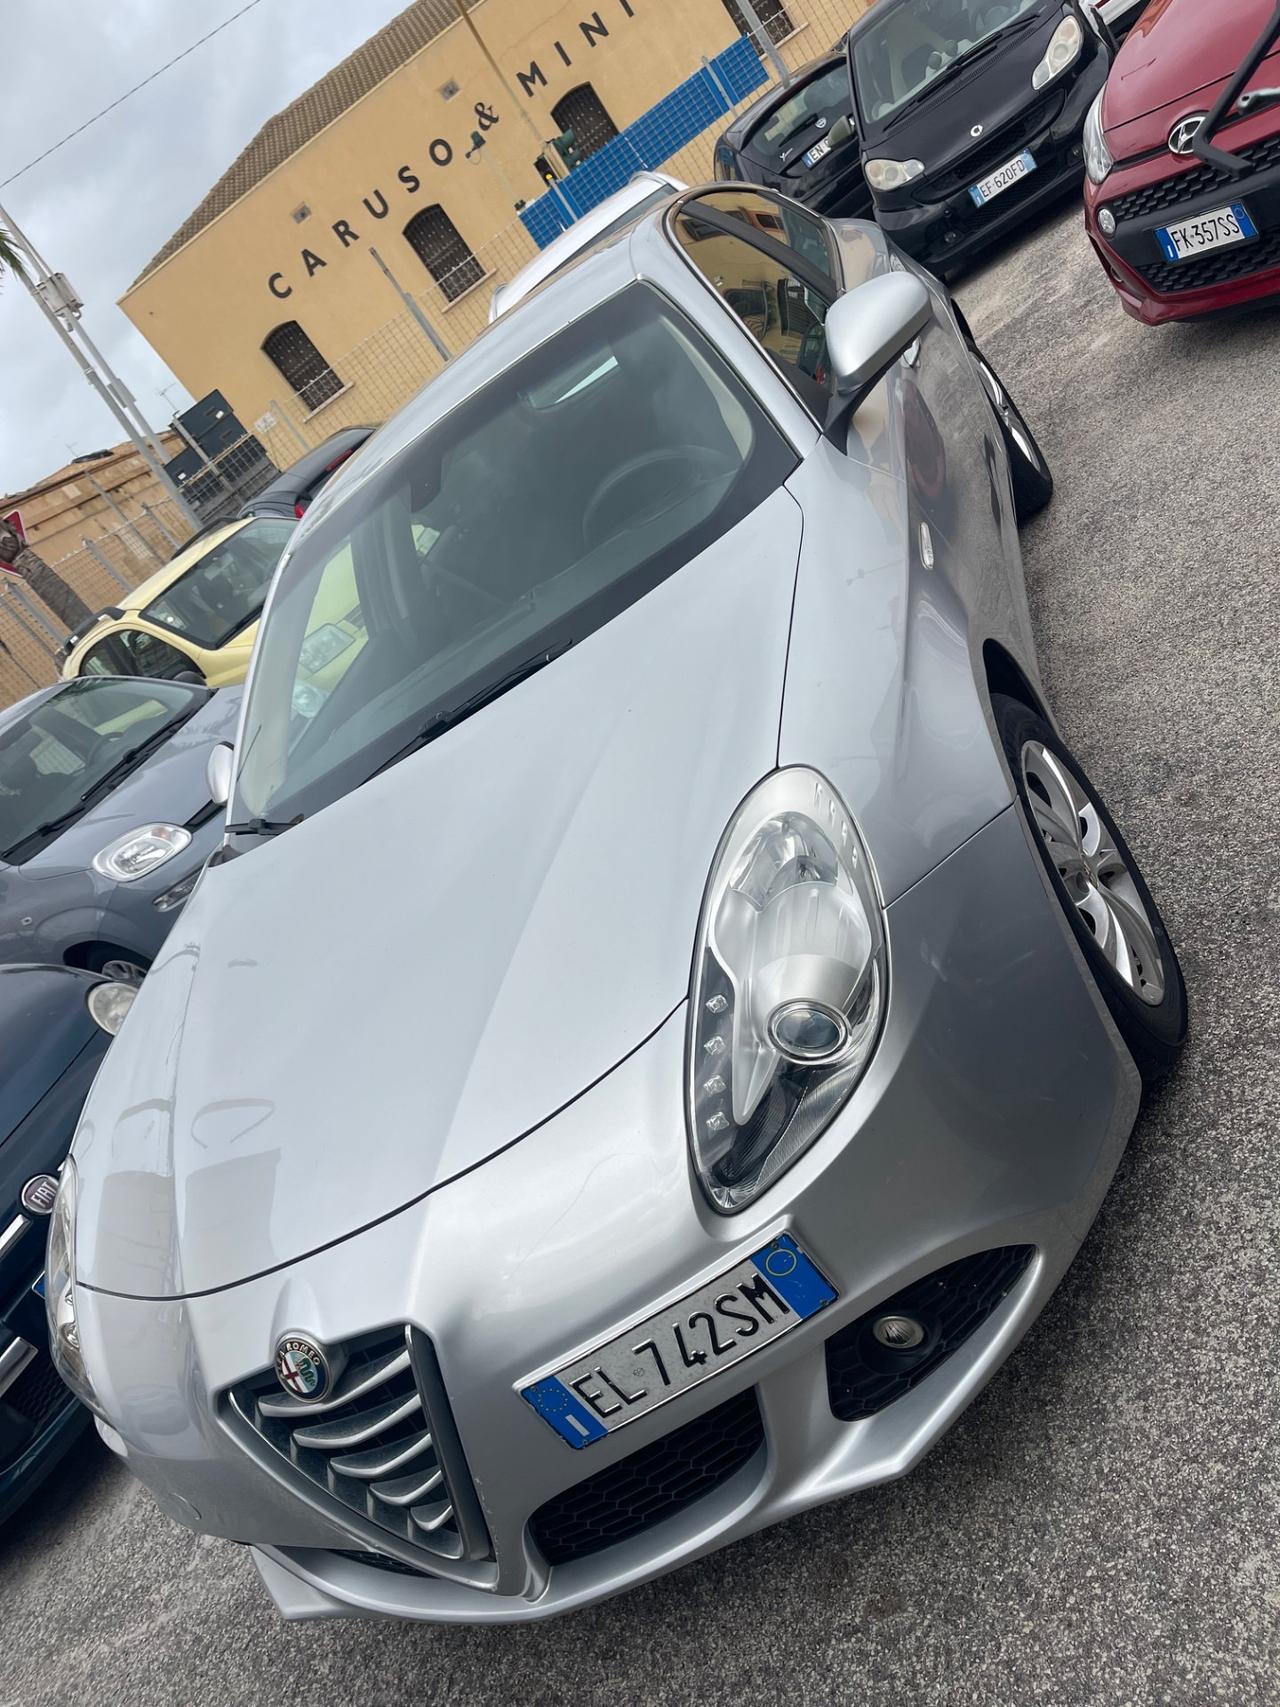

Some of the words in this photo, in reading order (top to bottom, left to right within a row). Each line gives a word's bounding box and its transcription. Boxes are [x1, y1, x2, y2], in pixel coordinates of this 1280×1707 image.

[268, 138, 453, 299] CARUSO
[474, 102, 499, 131] &
[30, 1181, 57, 1208] FIAT
[286, 1342, 320, 1366] ROMEO
